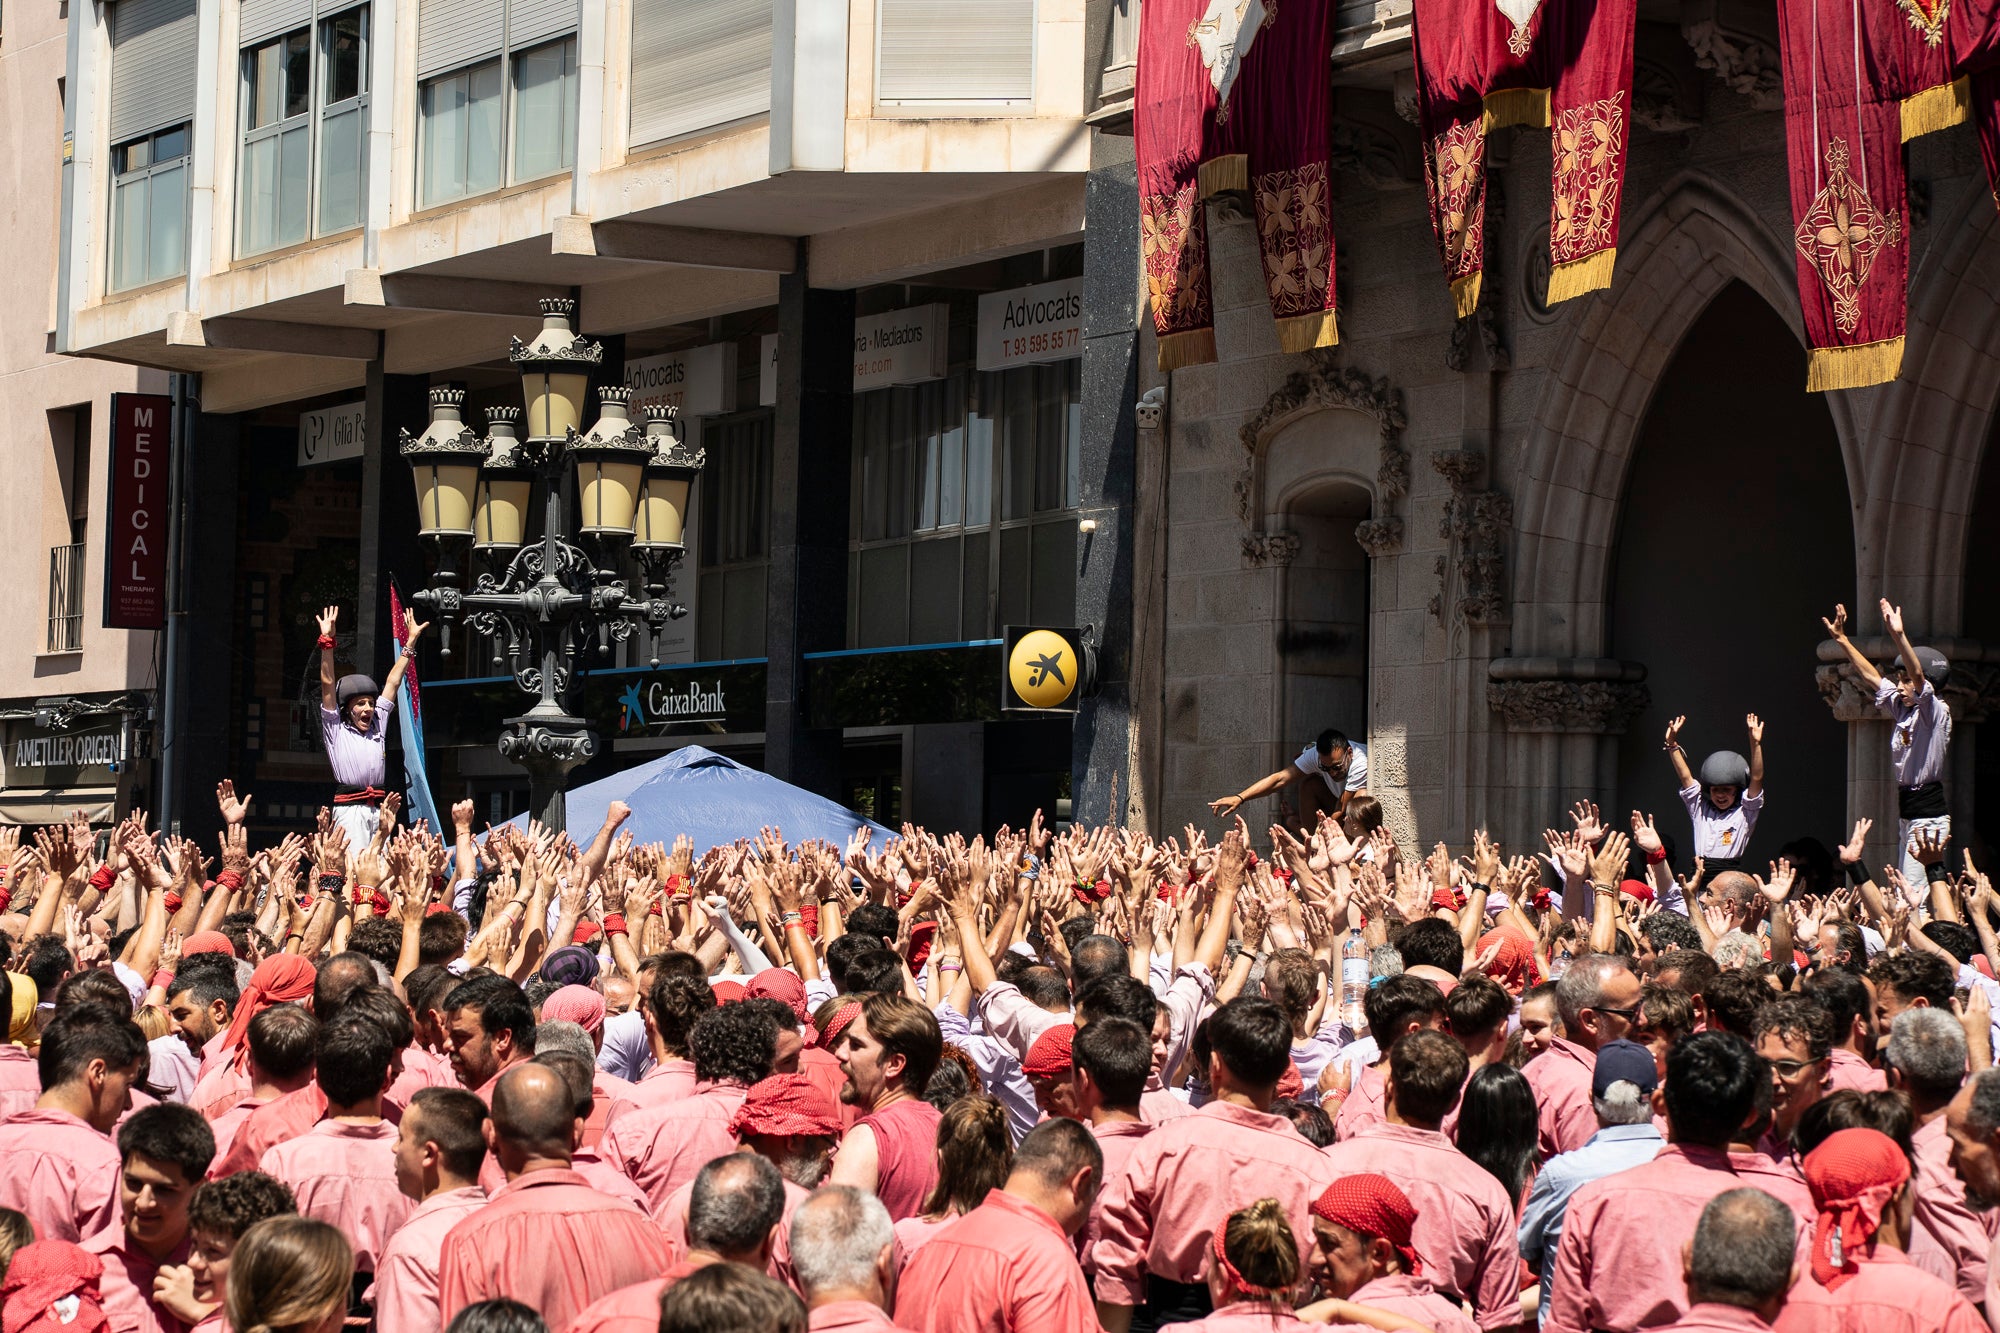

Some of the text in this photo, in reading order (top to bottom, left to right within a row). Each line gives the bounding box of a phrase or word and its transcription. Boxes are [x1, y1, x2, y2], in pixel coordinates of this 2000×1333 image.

[1003, 290, 1080, 330] Advocats
[874, 324, 923, 350] Mediadors
[1003, 328, 1079, 357] T. 93 595 55 77
[625, 359, 685, 390] Advocats
[334, 415, 353, 447] Glia
[130, 407, 153, 581] MEDICAL
[648, 679, 727, 716] CaixaBank
[15, 734, 120, 767] AMETLLER ORIGEN
